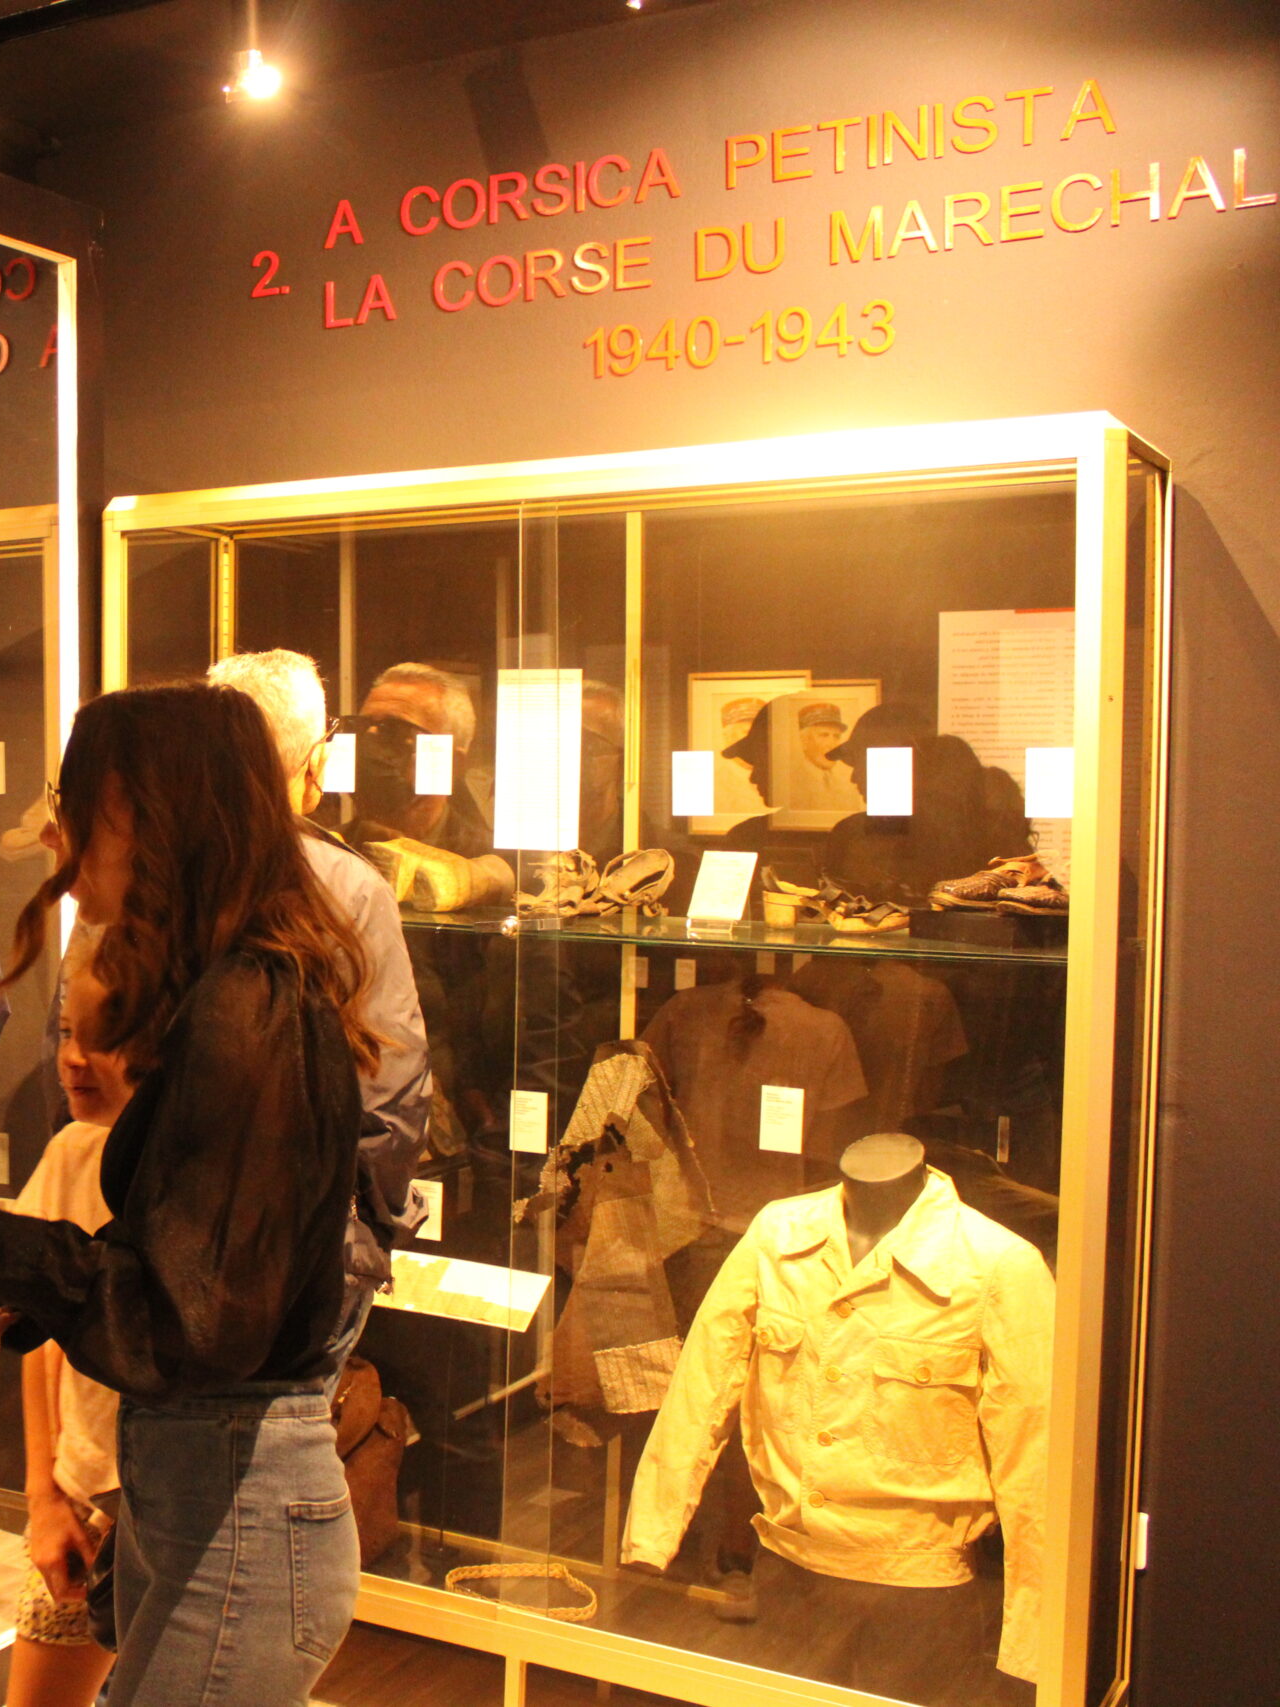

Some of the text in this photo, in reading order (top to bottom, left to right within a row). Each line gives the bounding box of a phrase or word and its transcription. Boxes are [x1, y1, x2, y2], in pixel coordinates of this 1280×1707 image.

[324, 78, 1117, 249] A CORSICA PETINISTA
[251, 250, 291, 298] 2.
[325, 147, 1278, 329] LA CORSE DU MARECHAL
[584, 298, 896, 379] 1940-1943
